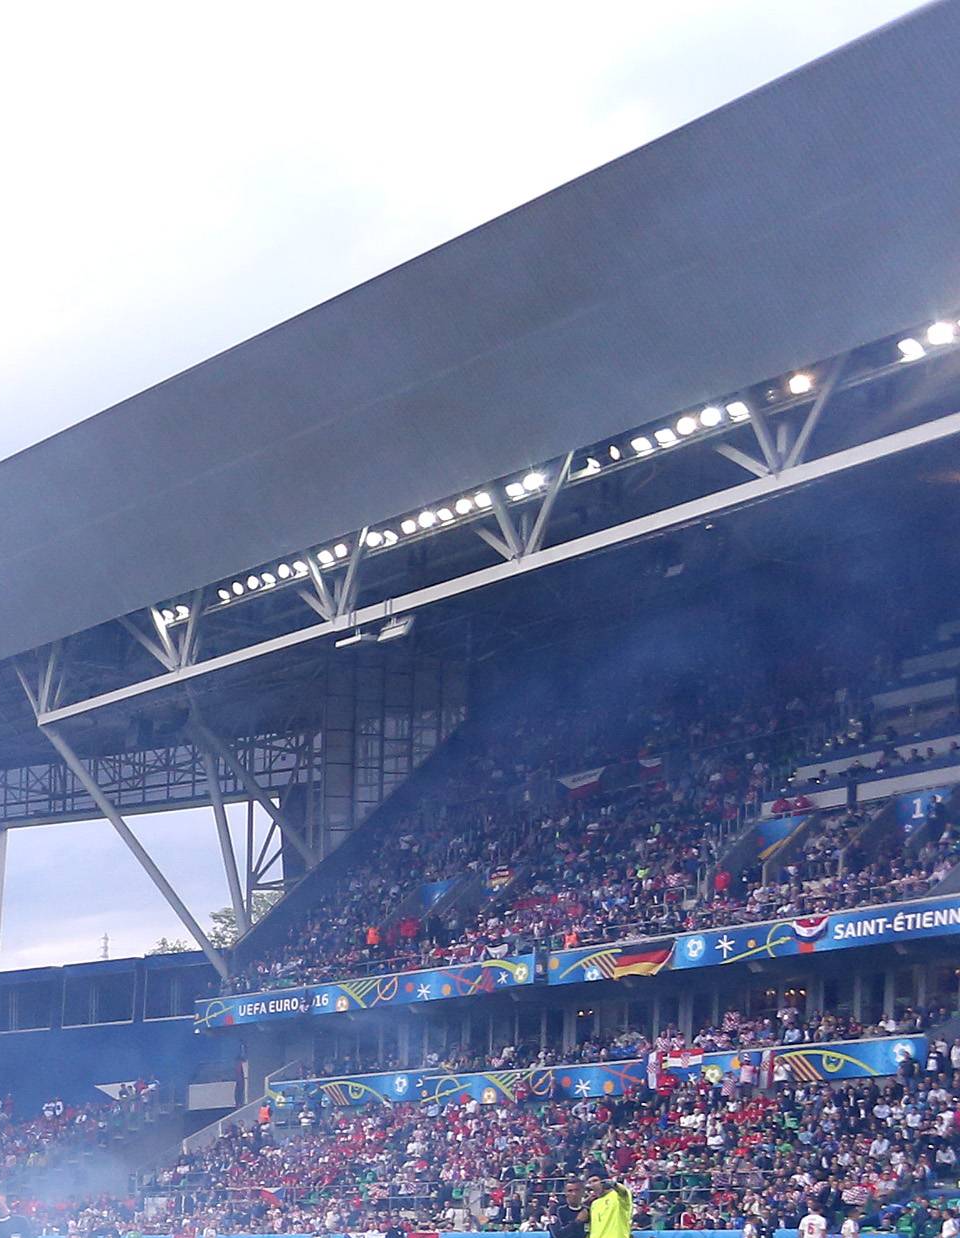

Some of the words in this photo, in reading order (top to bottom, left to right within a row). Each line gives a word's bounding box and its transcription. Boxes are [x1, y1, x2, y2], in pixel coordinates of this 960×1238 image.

[238, 1001, 268, 1017] UEFA
[269, 997, 299, 1013] EURO
[806, 1222, 815, 1236] 6
